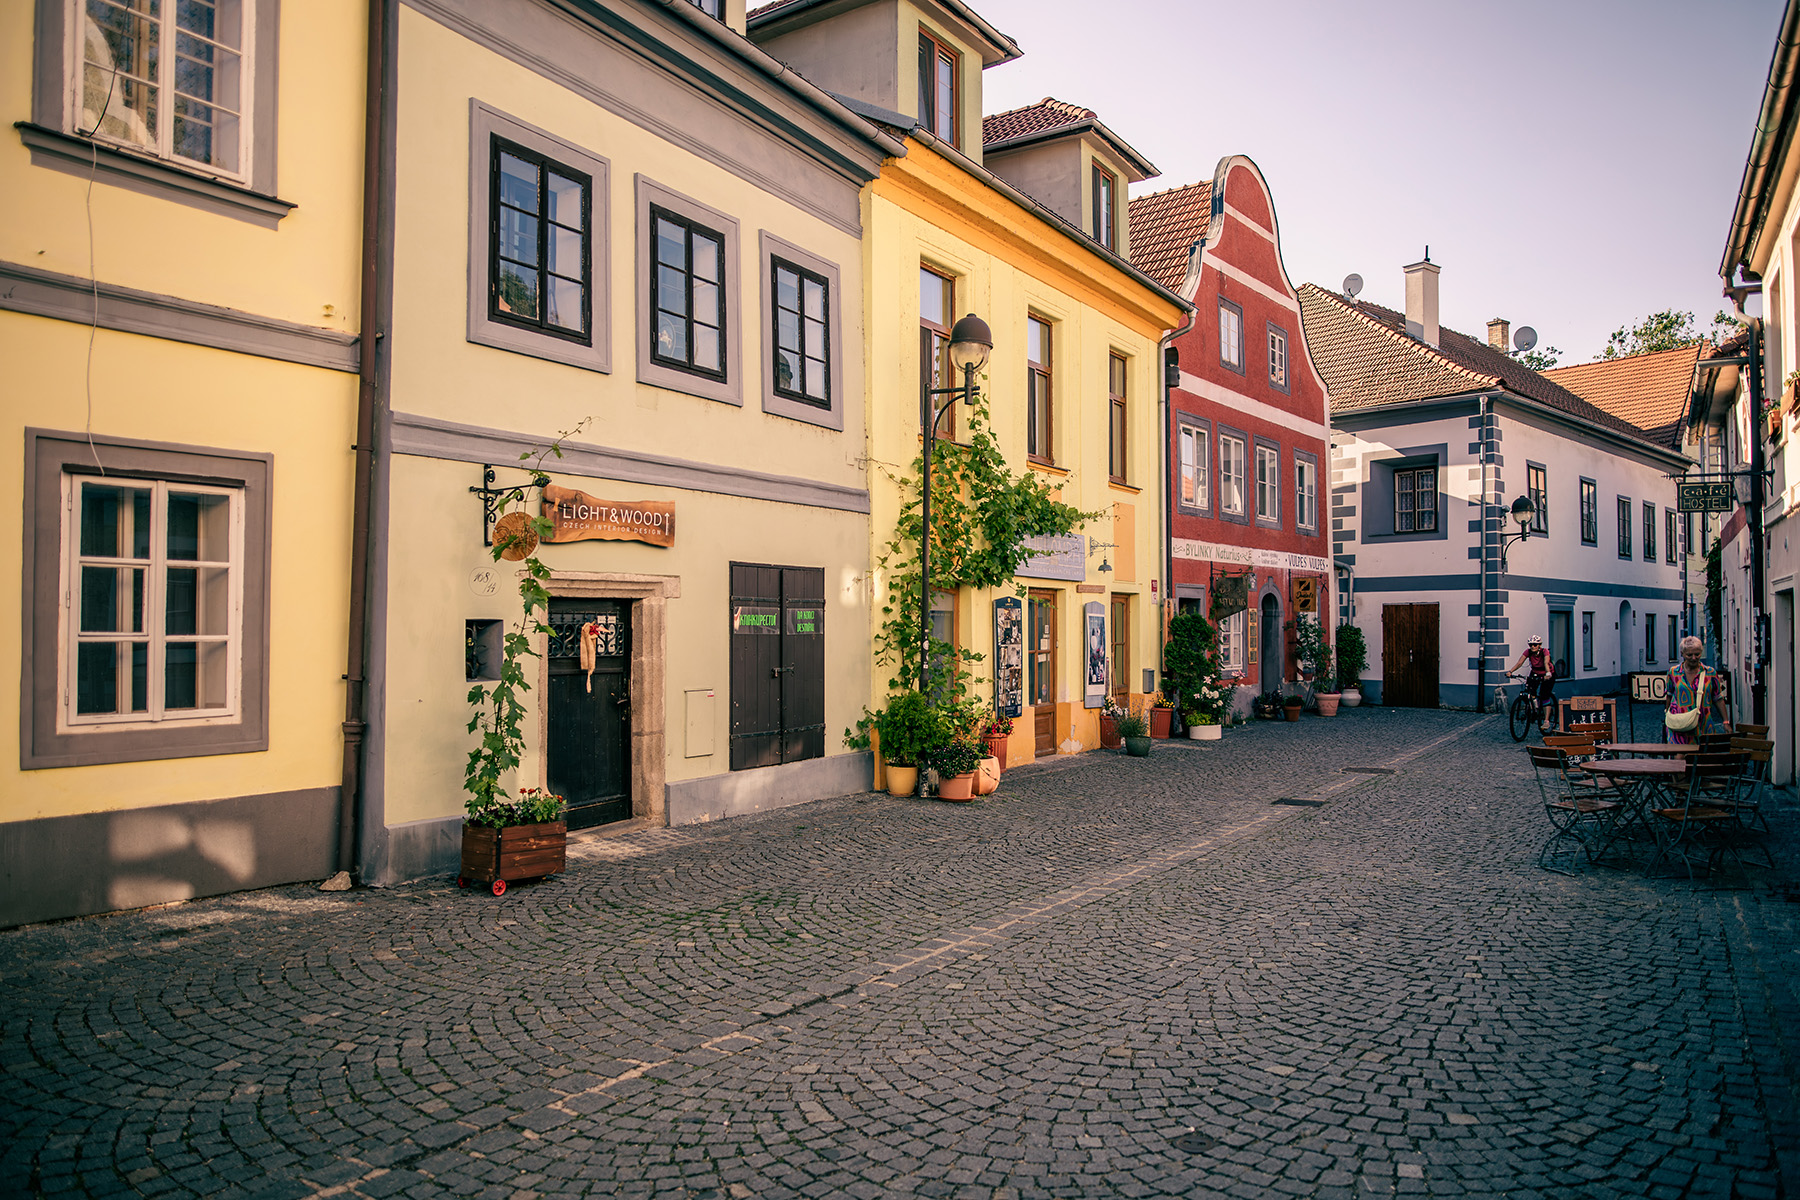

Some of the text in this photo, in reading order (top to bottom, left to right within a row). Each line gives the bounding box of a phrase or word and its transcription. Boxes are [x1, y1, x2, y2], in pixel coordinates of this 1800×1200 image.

[1683, 498, 1727, 509] HOSTEL
[563, 503, 662, 526] LIGHT&WOOD
[593, 524, 630, 533] INTERIOR
[634, 527, 661, 535] DESIGN
[1185, 543, 1213, 558] BYLINKY
[1288, 554, 1308, 568] VULPES
[1309, 558, 1326, 571] VULPES
